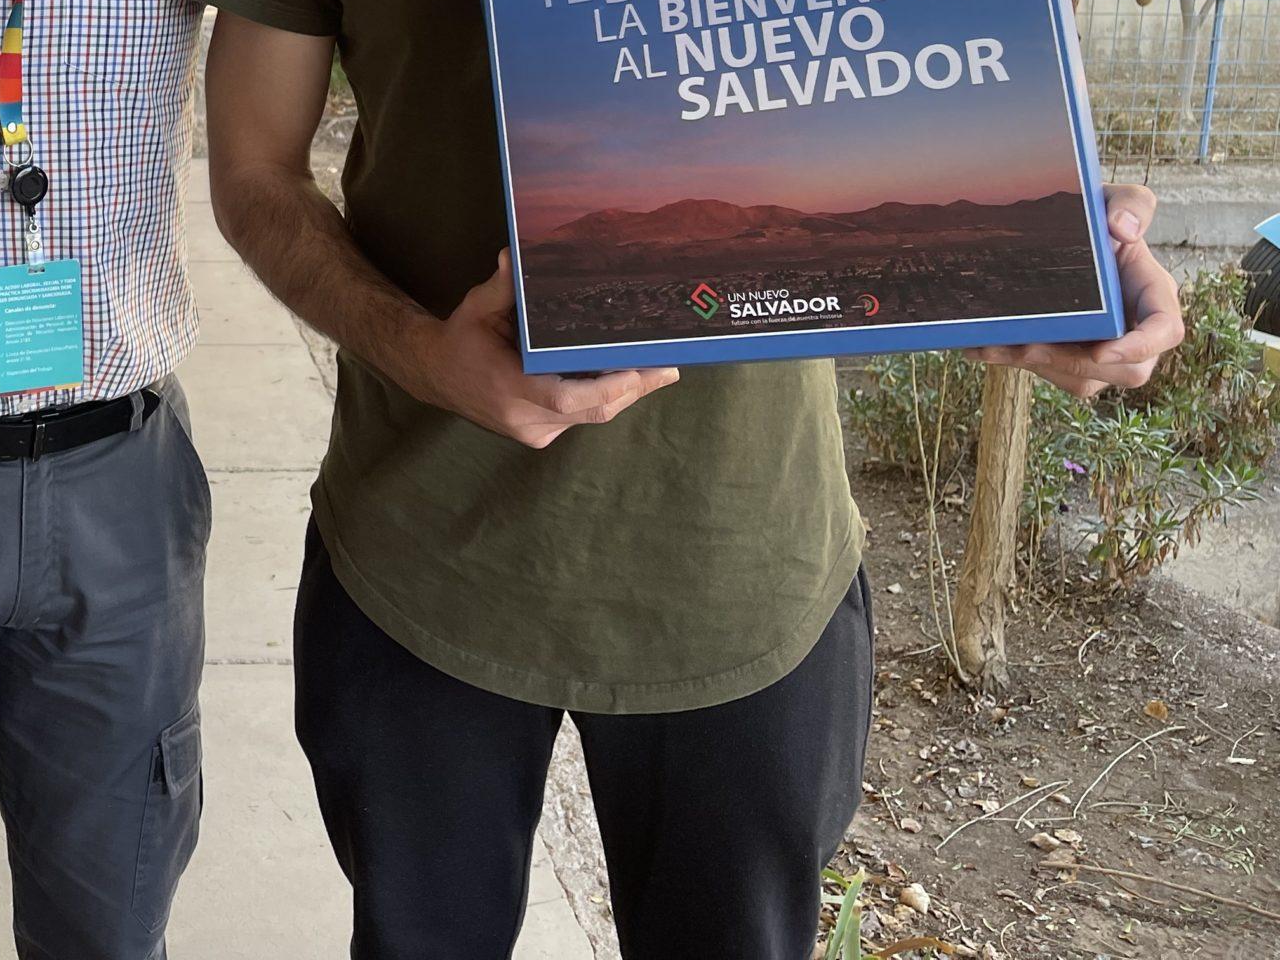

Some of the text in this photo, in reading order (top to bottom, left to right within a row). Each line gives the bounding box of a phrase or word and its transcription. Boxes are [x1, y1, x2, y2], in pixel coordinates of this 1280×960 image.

[594, 3, 647, 42] LA
[614, 7, 884, 83] AL NUEVO
[677, 38, 1010, 120] SALVADOR
[727, 289, 789, 303] UN NUEVO
[730, 296, 841, 318] SALVADOR
[769, 316, 788, 324] fuerza
[820, 313, 843, 321] historia
